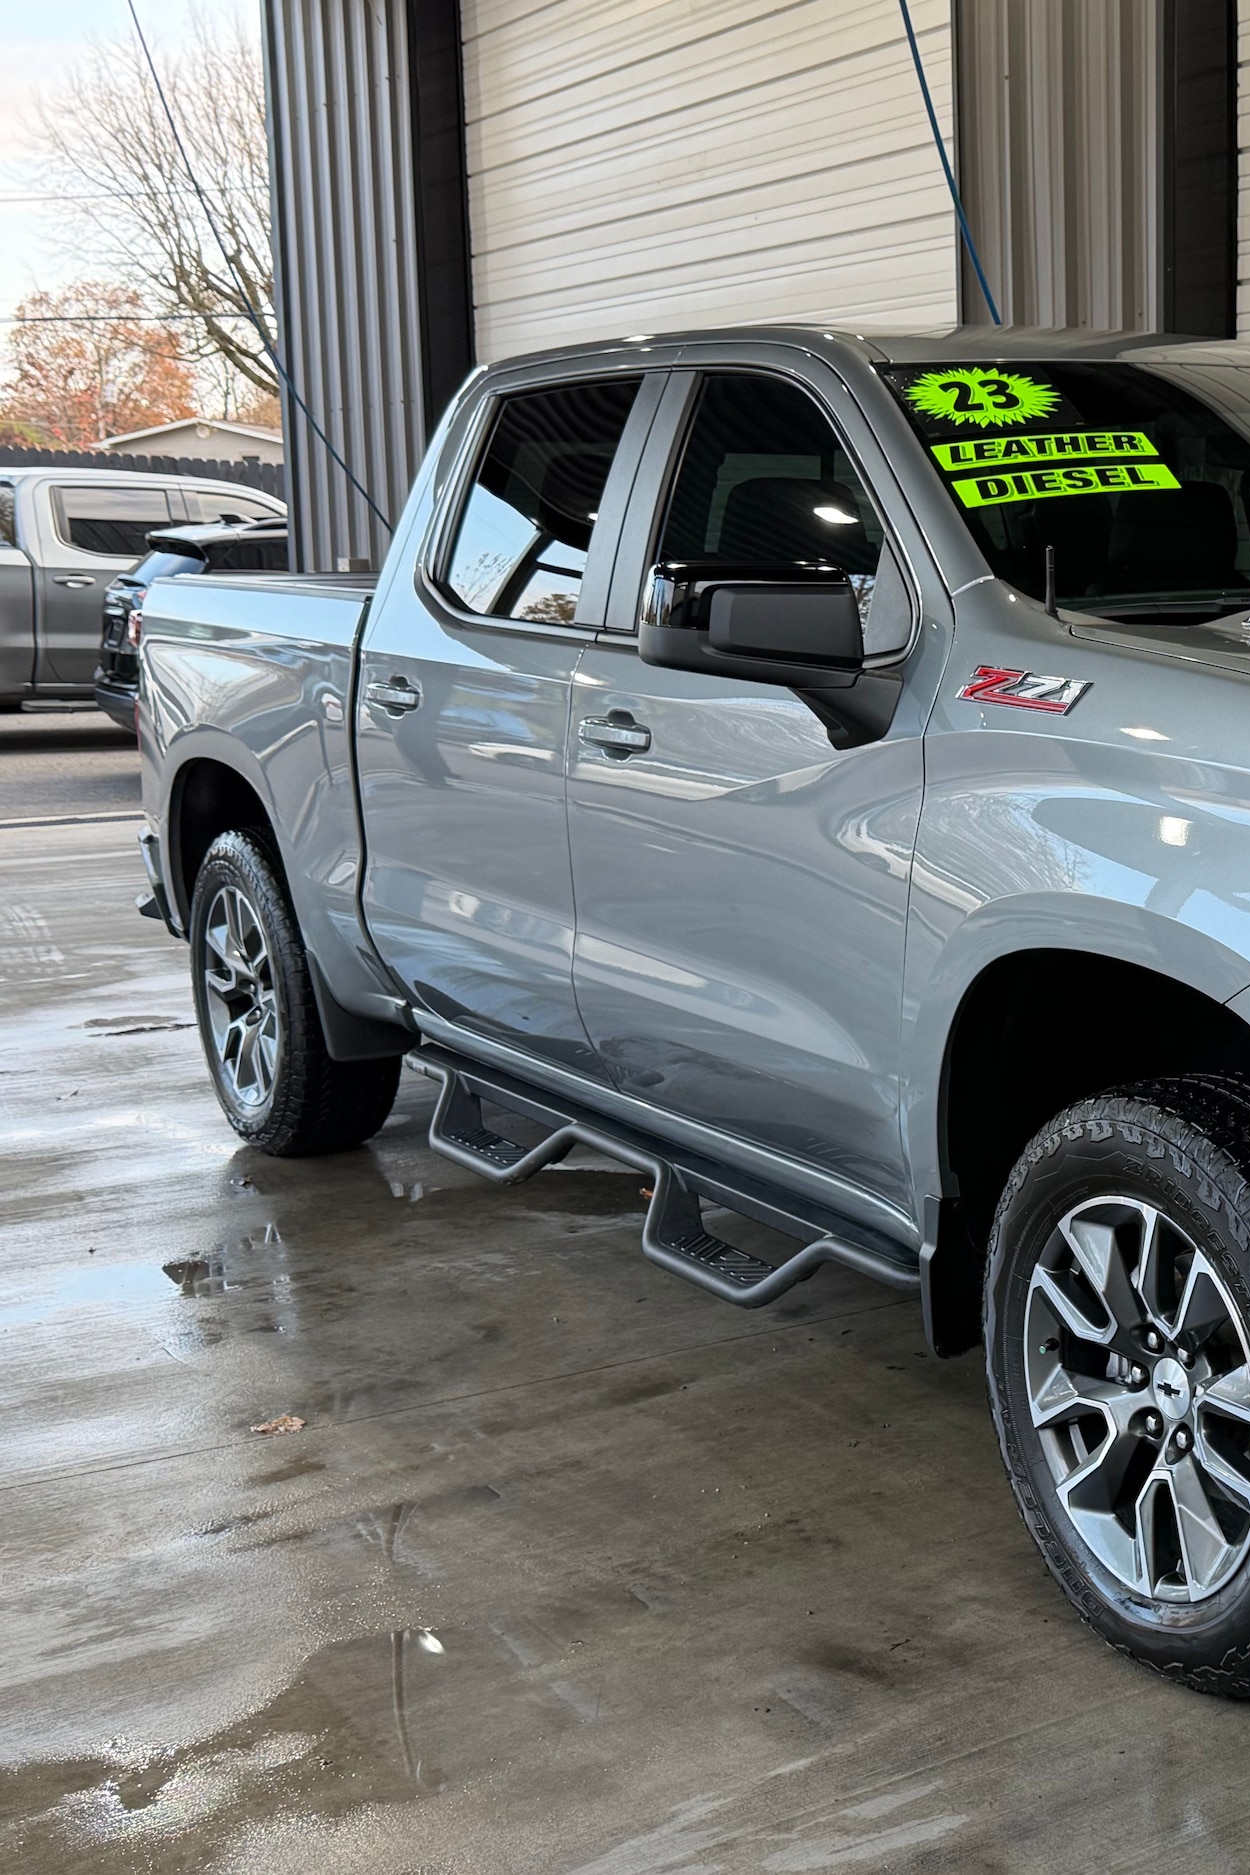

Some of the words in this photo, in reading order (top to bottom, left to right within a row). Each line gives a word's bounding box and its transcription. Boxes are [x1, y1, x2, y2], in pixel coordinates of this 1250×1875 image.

[938, 379, 1023, 413] 23
[948, 433, 1143, 465] LEATHER
[974, 466, 1159, 502] DIESEL
[955, 664, 1094, 717] Z71
